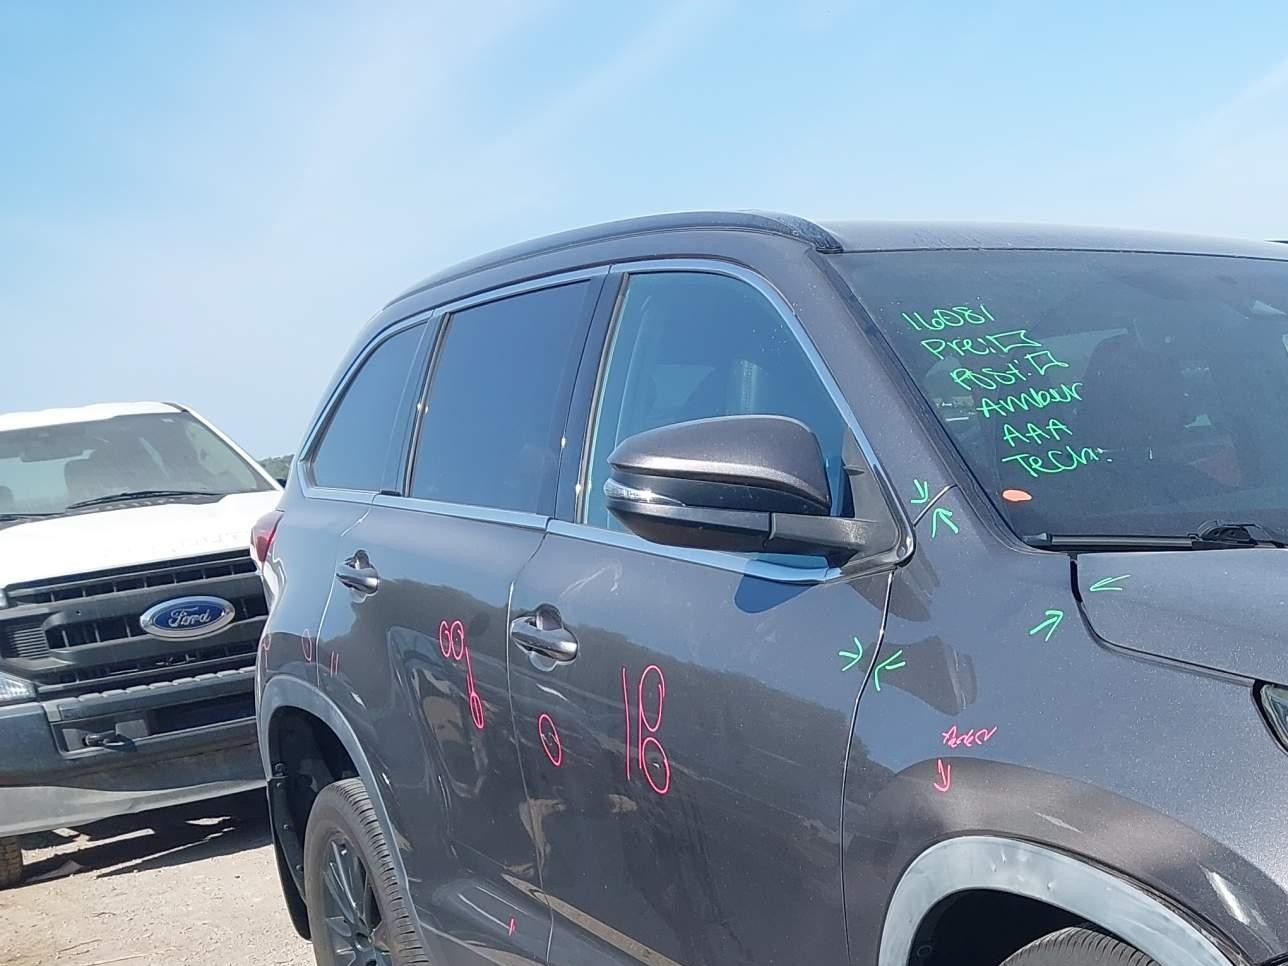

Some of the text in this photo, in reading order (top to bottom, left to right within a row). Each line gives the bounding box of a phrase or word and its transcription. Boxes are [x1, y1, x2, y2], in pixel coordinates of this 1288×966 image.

[902, 304, 994, 331] 16081
[1003, 419, 1073, 447] AAA
[168, 606, 211, 628] Ford
